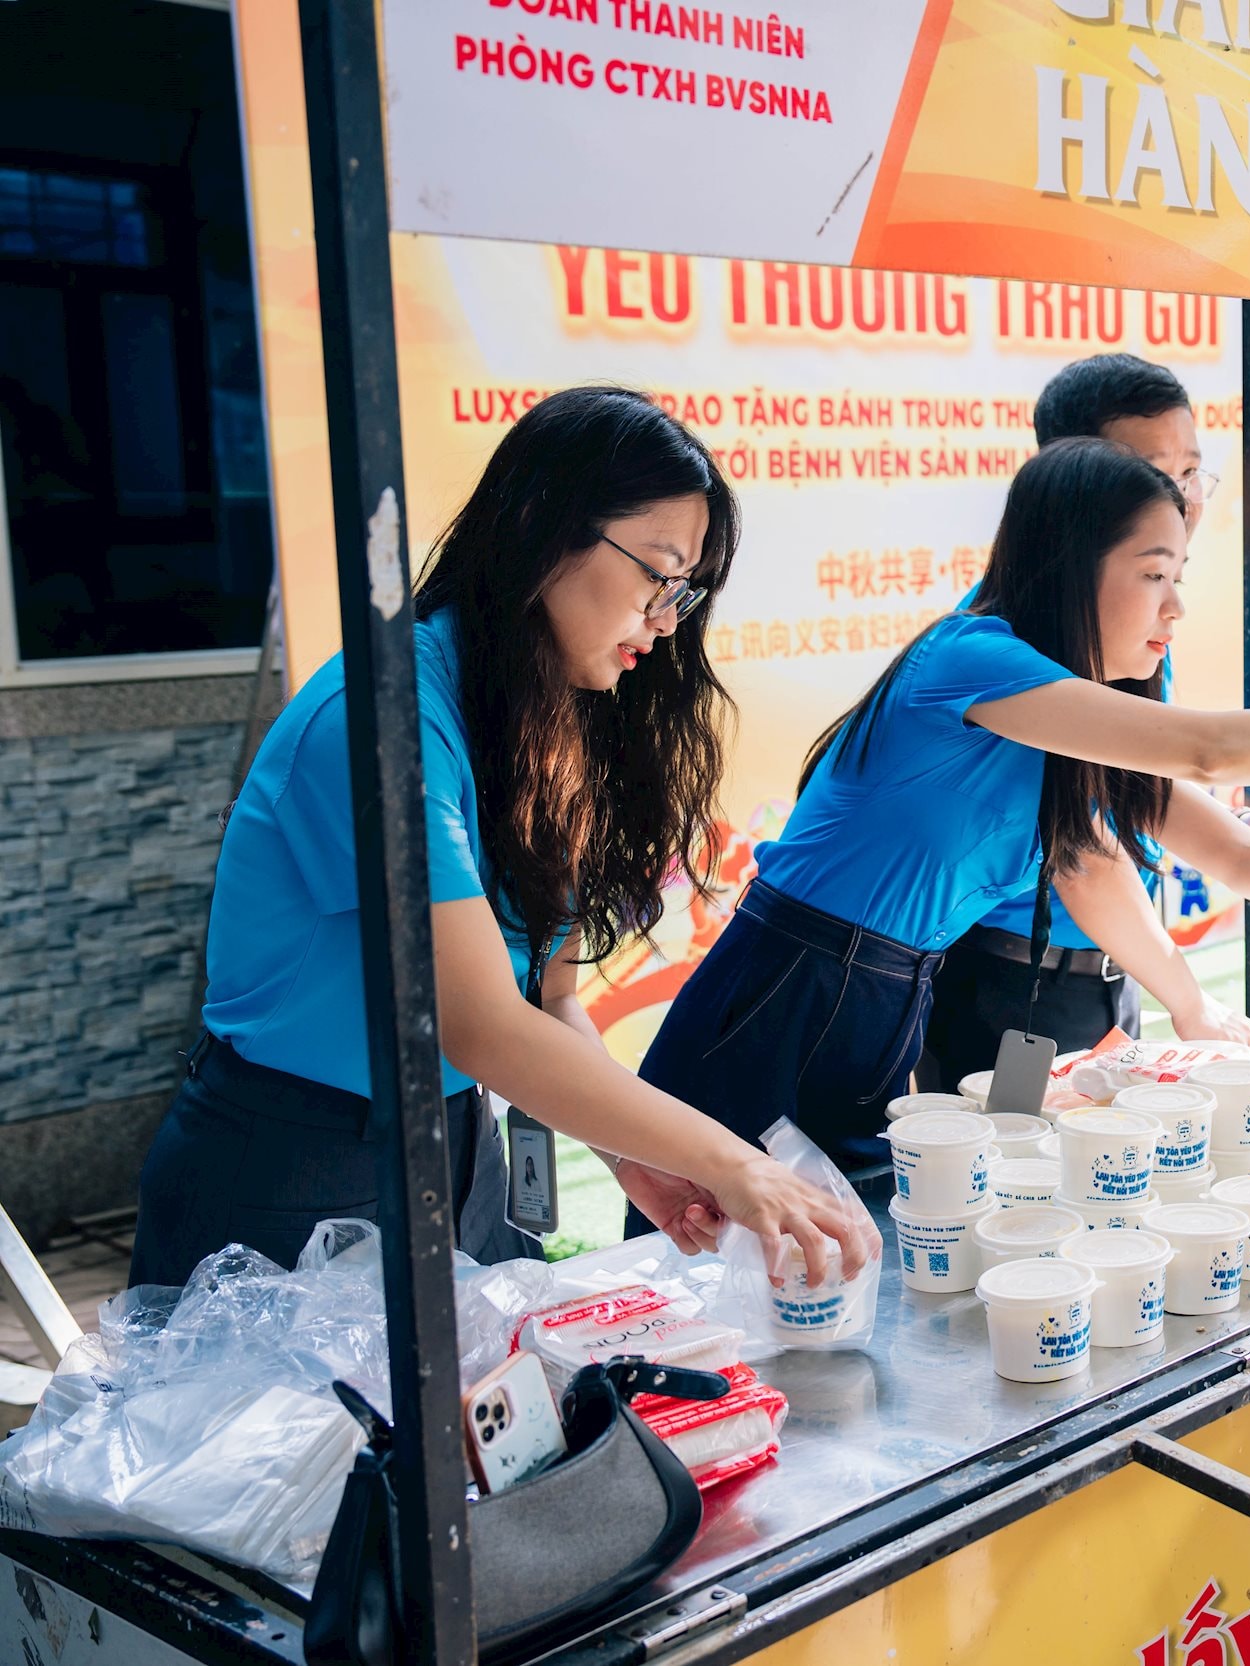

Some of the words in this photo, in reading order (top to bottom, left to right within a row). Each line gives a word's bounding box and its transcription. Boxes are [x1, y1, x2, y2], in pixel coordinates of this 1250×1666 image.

[605, 0, 724, 46] THANH
[732, 13, 805, 60] NIÊN
[455, 33, 595, 89] PHÒNG
[604, 59, 697, 105] CTXH
[706, 73, 833, 125] BVSNNA
[733, 387, 810, 437] TẶNG
[818, 391, 893, 428] BÁNH
[901, 398, 983, 429] TRUNG
[769, 440, 842, 488] BỆNH
[851, 441, 910, 488] VIỆN
[919, 439, 968, 477] SẢN
